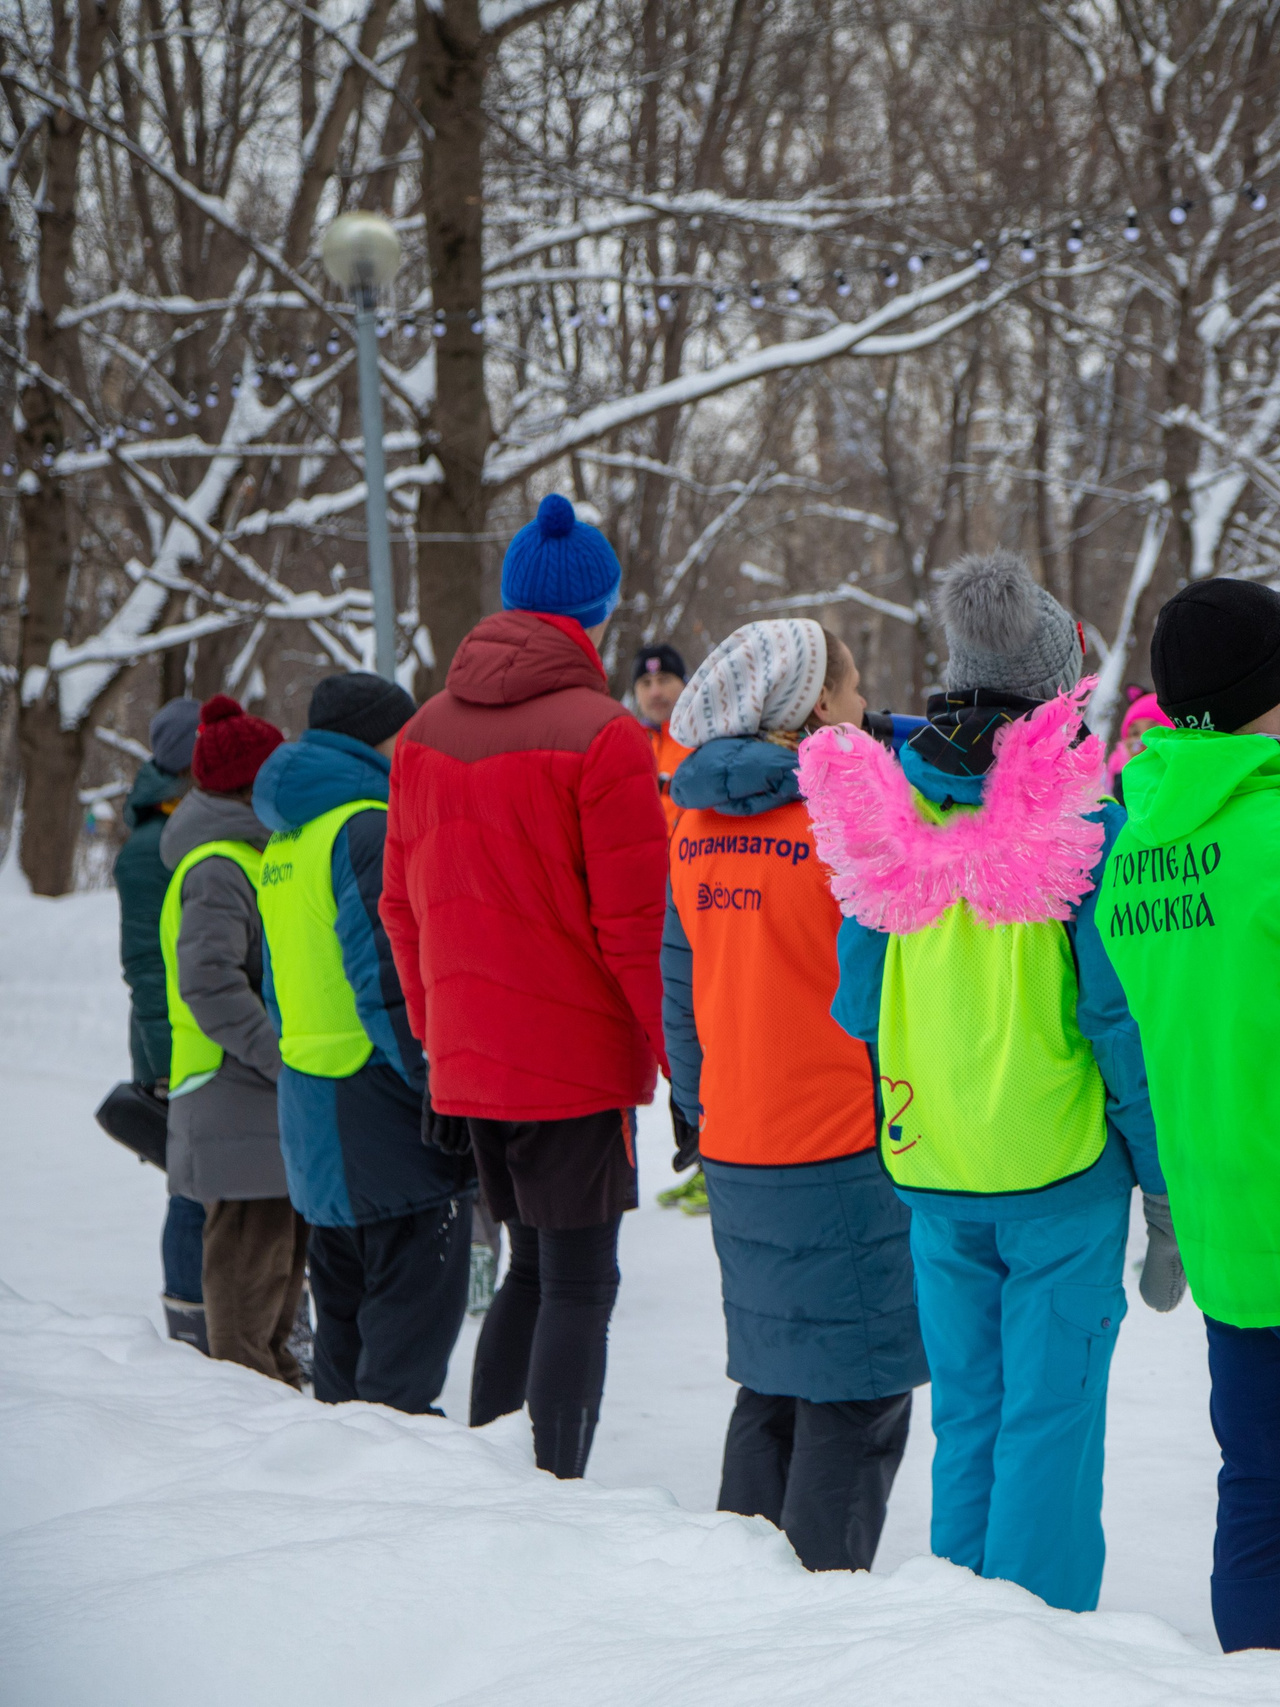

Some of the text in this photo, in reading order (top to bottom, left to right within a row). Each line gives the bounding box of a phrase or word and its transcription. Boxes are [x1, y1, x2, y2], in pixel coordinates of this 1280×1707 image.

[678, 835, 810, 866] Организатор
[1113, 842, 1221, 888] ТОРПЕДО
[1110, 892, 1216, 938] МОСКВА
